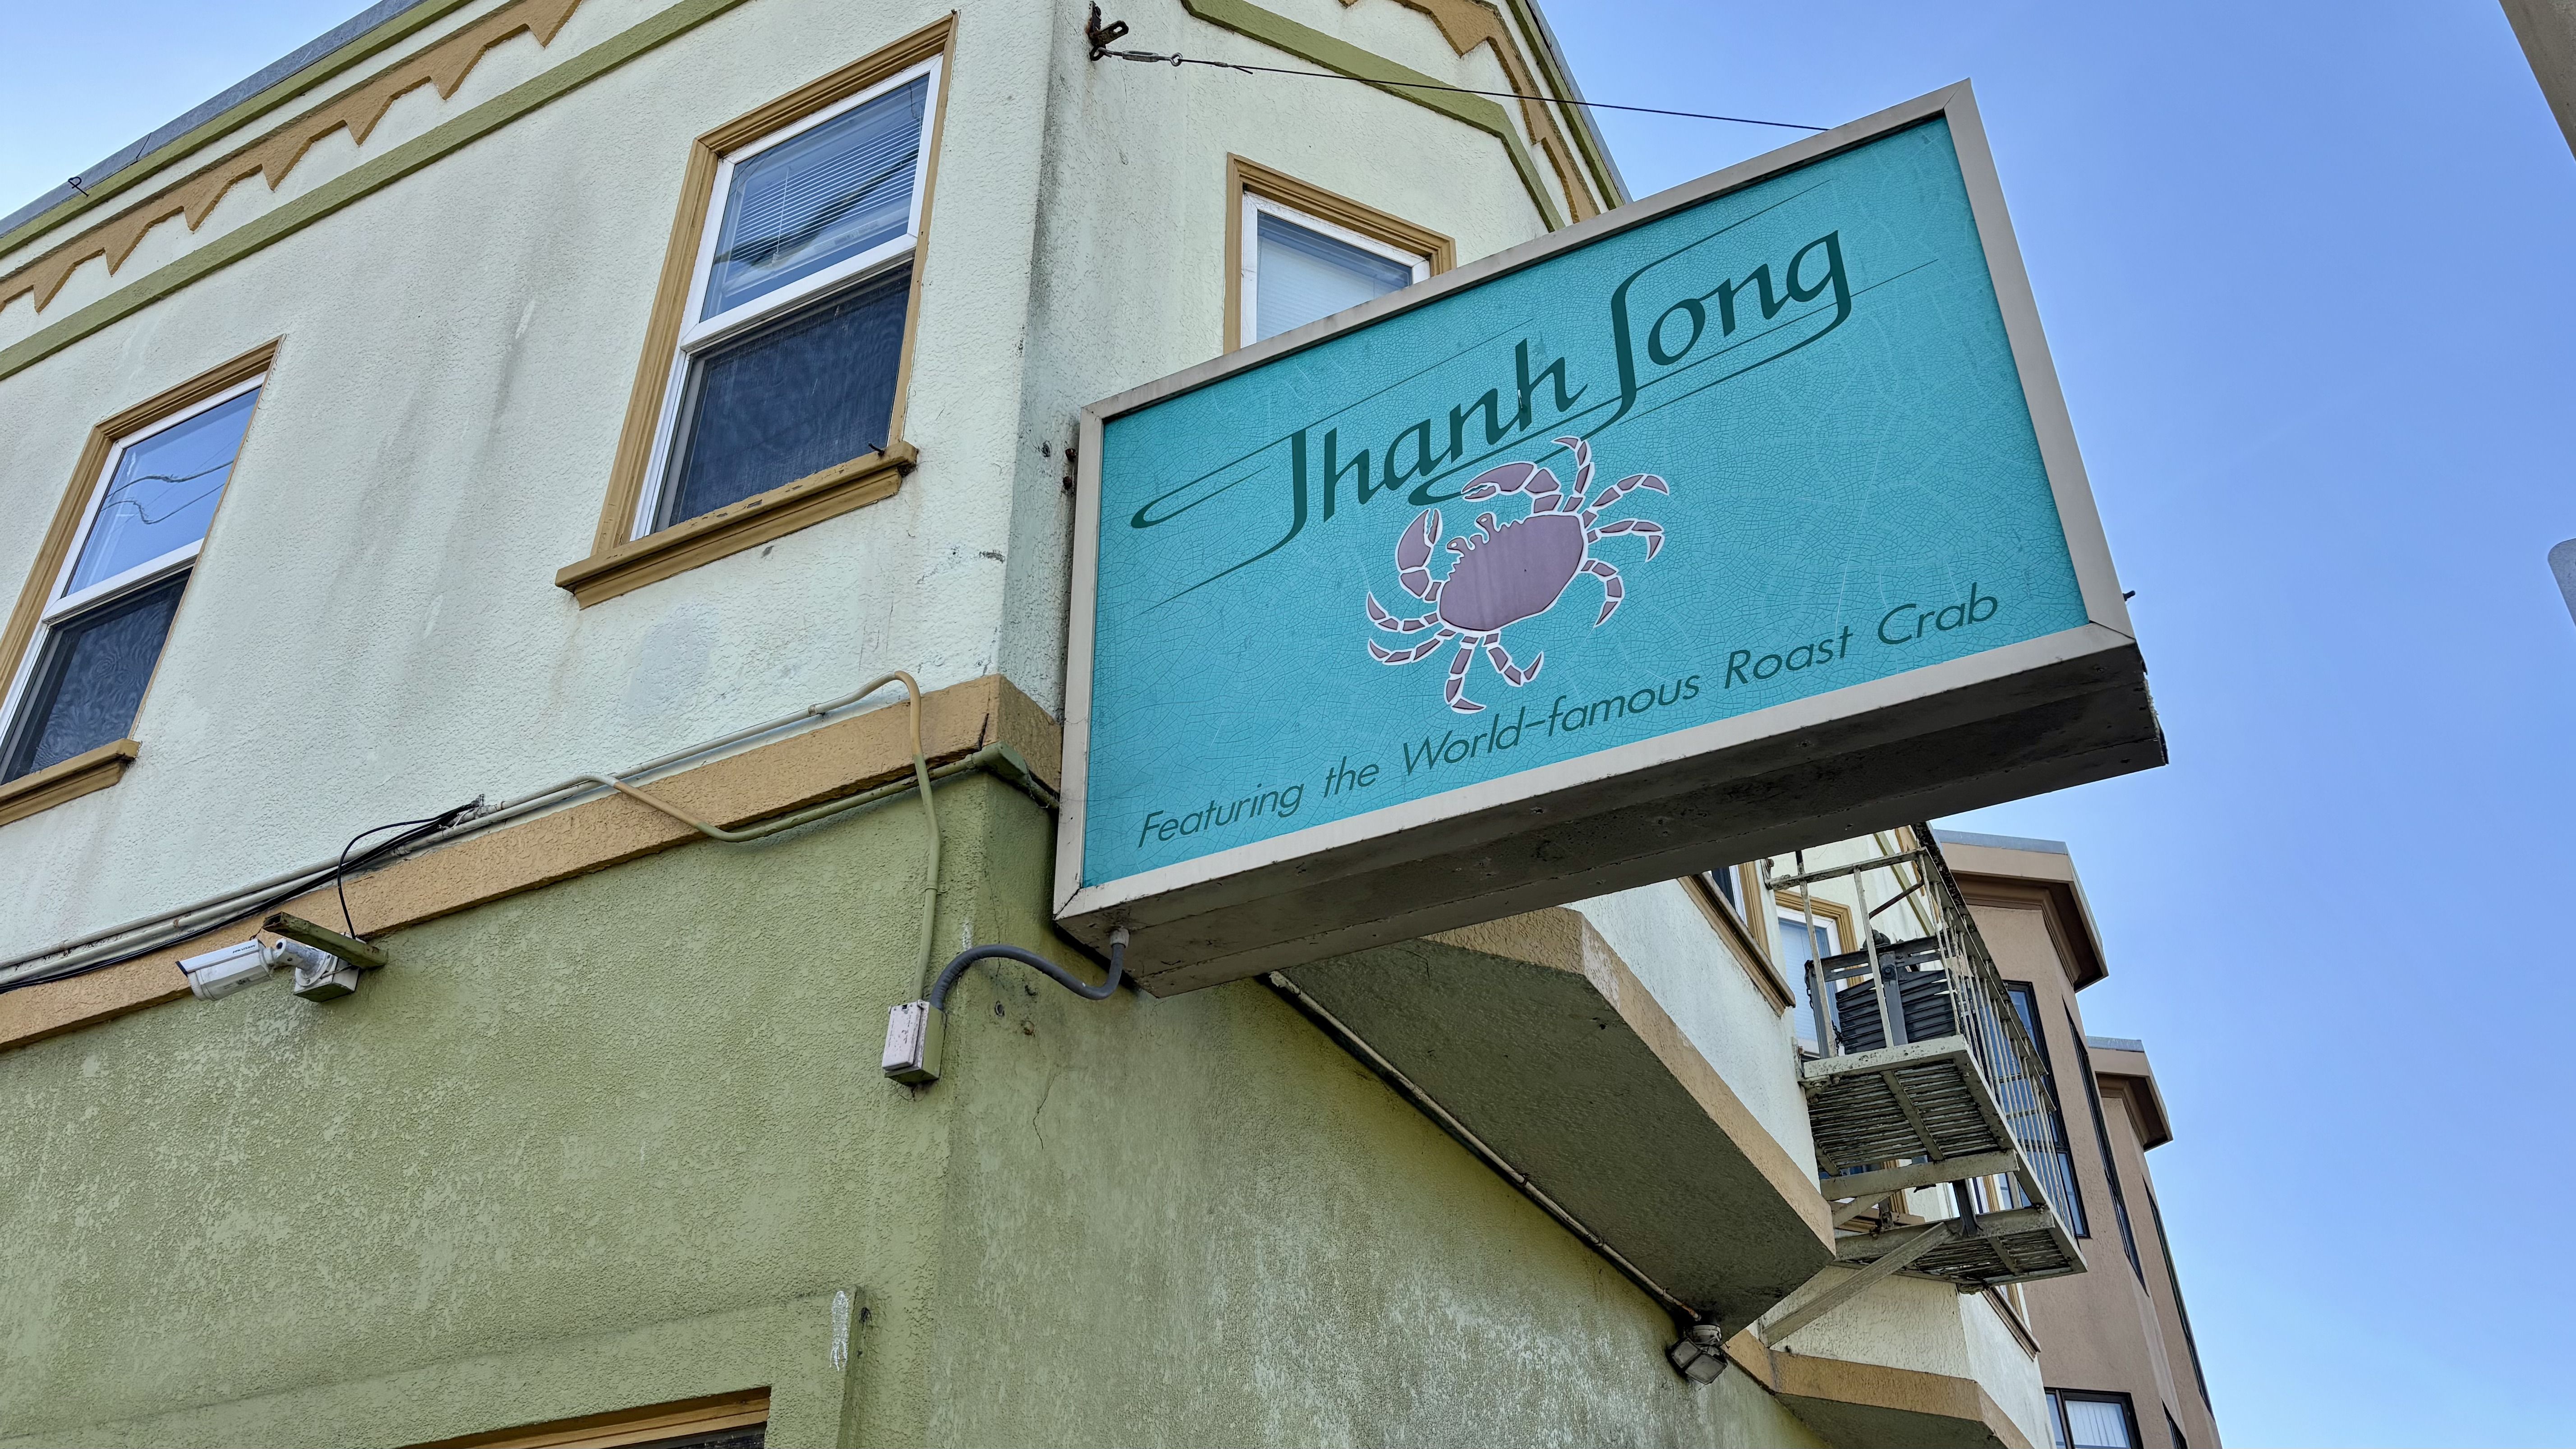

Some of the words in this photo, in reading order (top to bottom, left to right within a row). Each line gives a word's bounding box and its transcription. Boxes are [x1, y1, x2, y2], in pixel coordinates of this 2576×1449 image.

[1138, 783, 1304, 848] Featuring
[1324, 756, 1380, 798] the
[1403, 675, 1700, 776] World-famous
[1725, 626, 1853, 689] Roast
[1877, 582, 1998, 644] Crab
